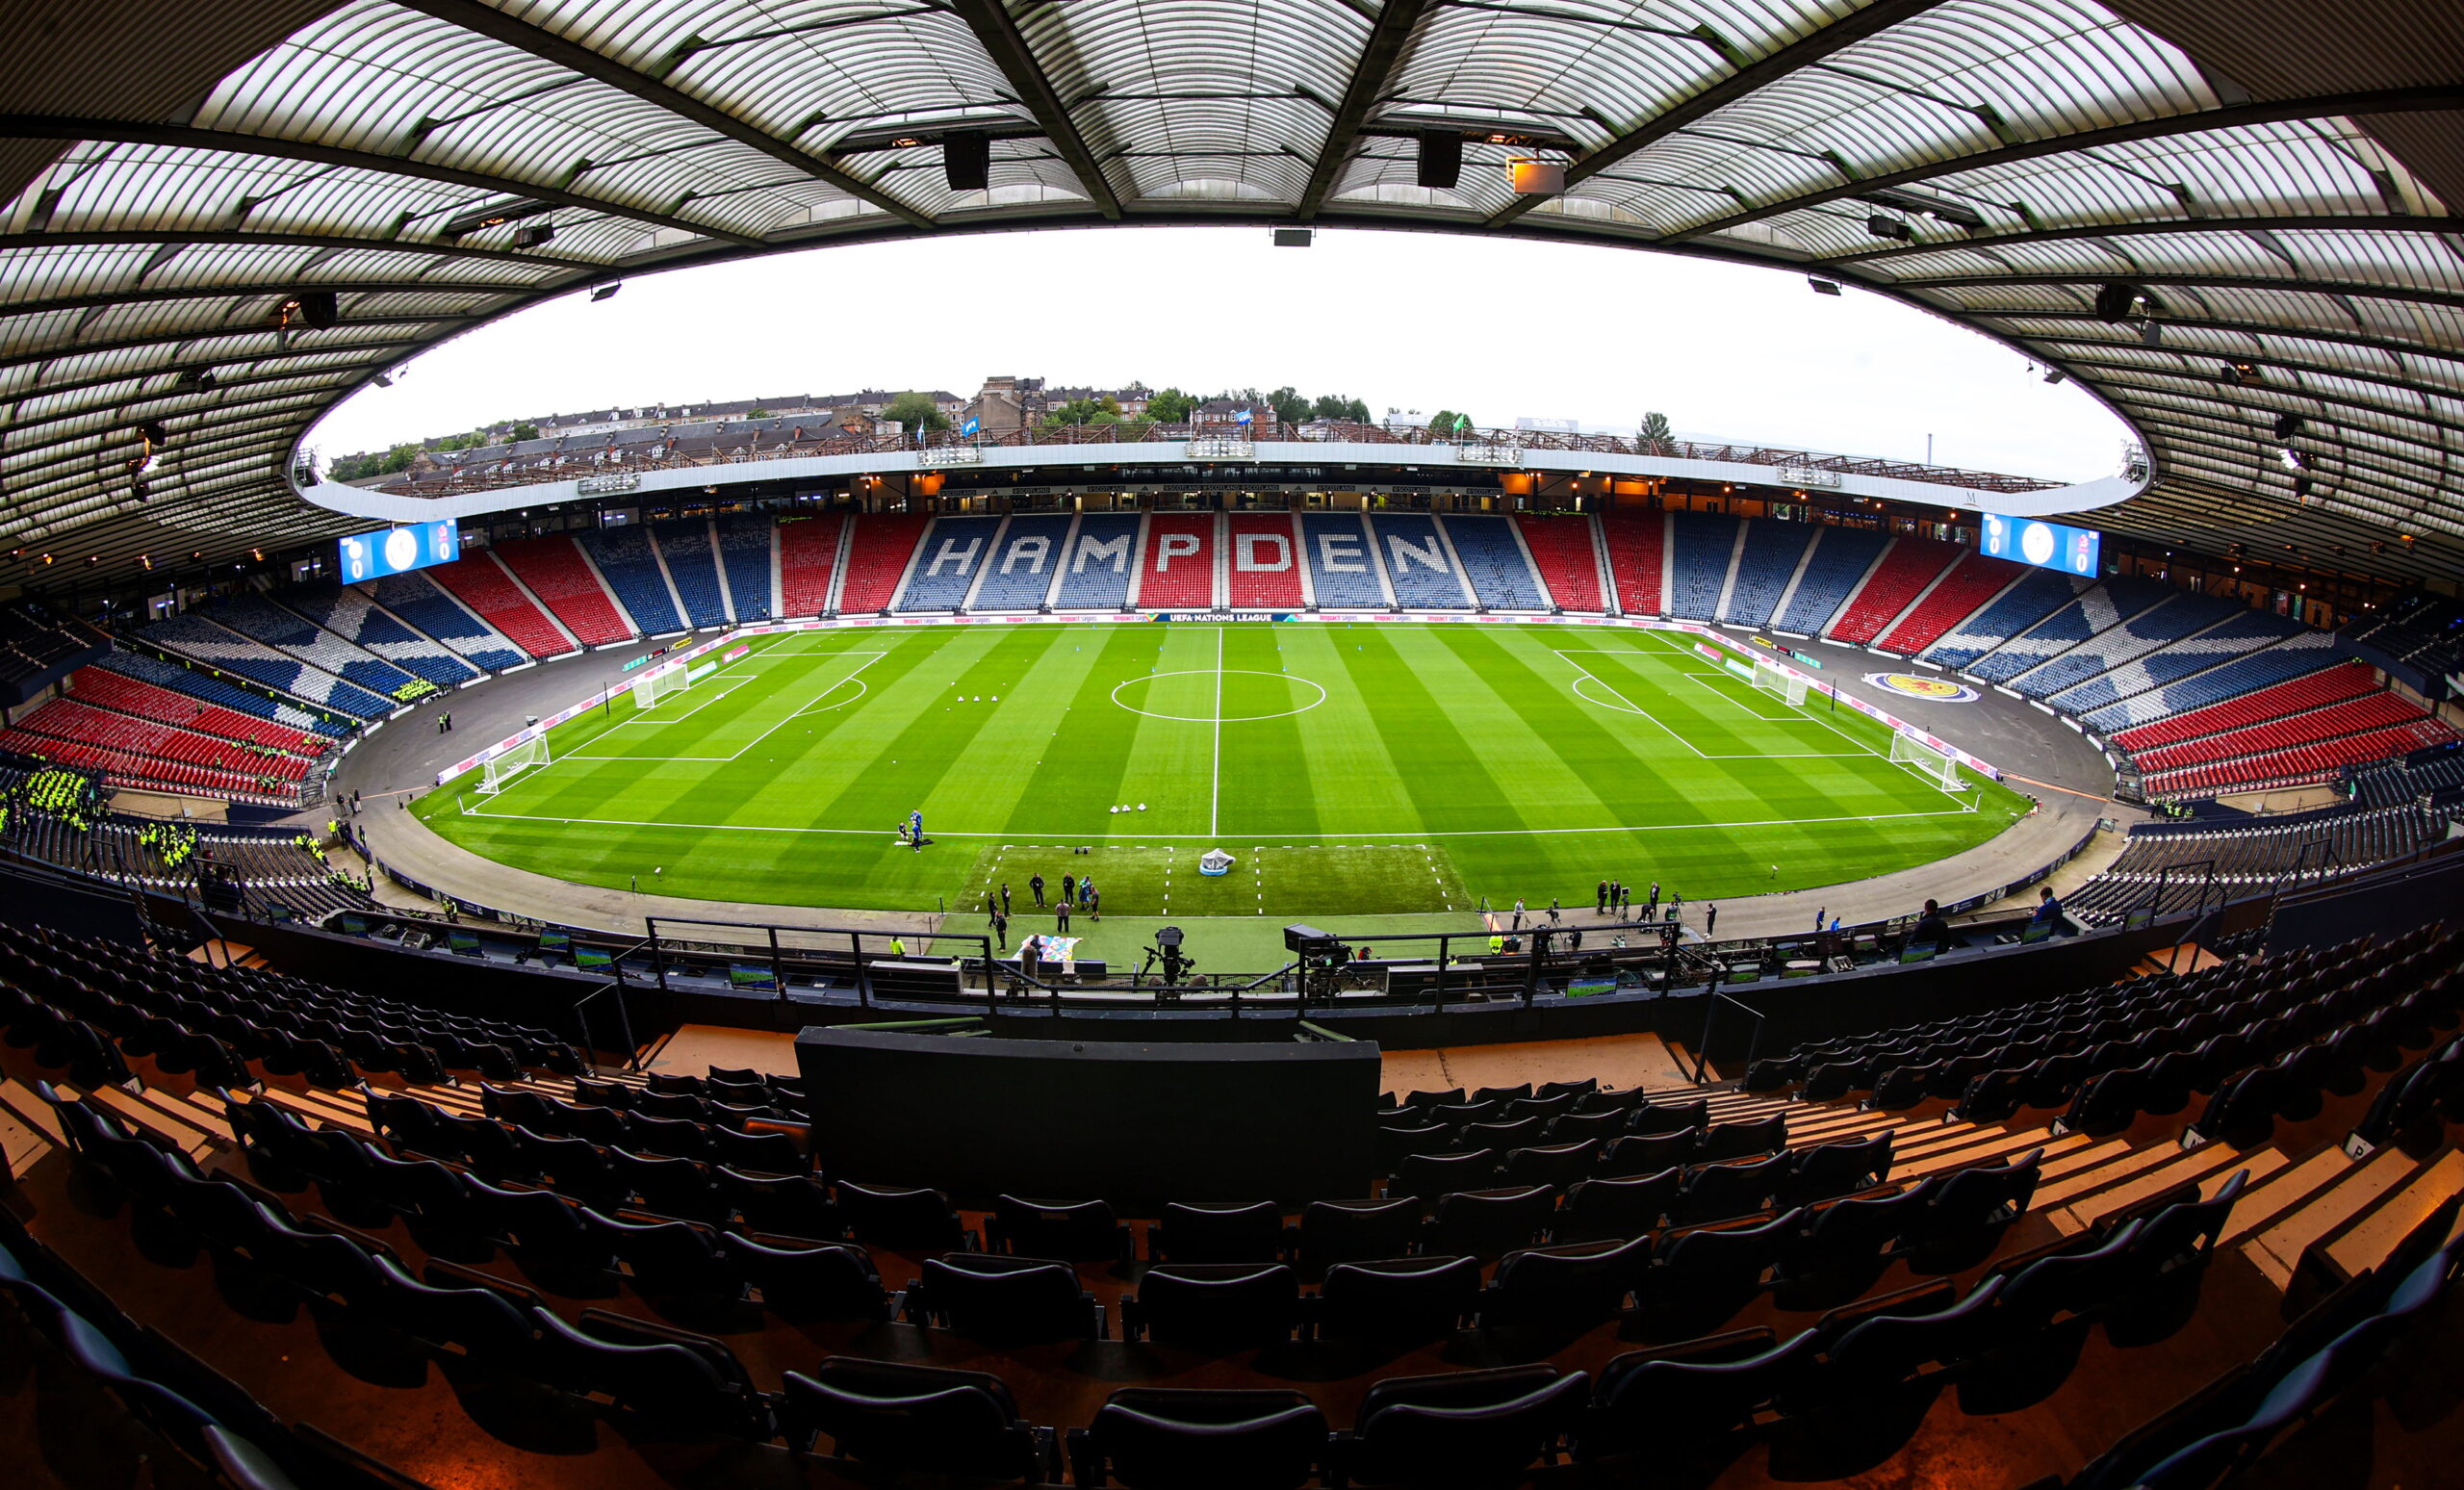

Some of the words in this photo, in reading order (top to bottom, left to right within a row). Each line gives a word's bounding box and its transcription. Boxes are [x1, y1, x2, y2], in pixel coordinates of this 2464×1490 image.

[1965, 492, 1977, 503] M
[927, 533, 1449, 577] HAMPDEN
[2353, 1144, 2364, 1158] P
